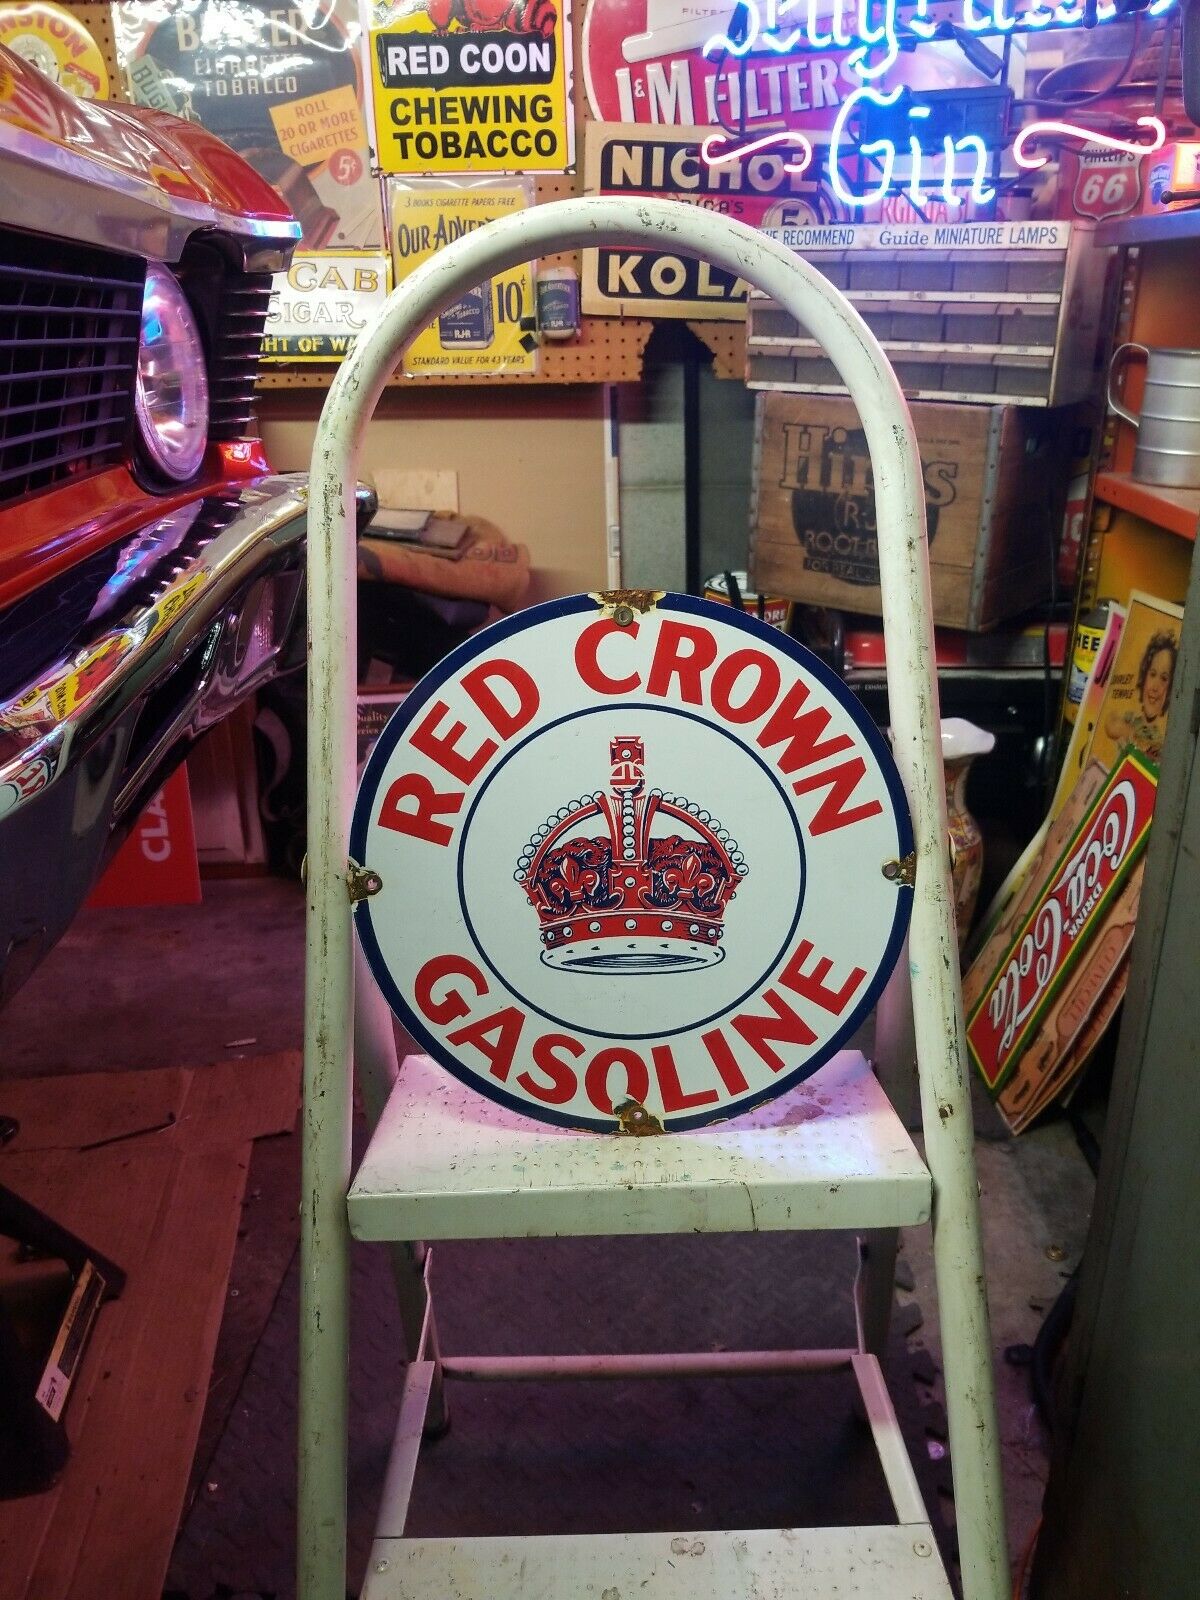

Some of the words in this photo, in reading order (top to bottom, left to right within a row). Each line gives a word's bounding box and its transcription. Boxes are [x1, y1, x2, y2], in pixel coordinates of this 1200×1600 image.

[176, 9, 312, 52] BER
[387, 45, 450, 76] RED
[459, 43, 551, 74] COON
[203, 77, 298, 97] TOBACCO
[295, 100, 329, 118] ROLL
[390, 94, 553, 126] CHEWING
[280, 128, 296, 142] 20
[296, 123, 317, 138] OR
[319, 110, 358, 133] MORE
[289, 127, 358, 157] CIGARETTES
[393, 129, 557, 160] TOBACCO
[830, 87, 998, 206] Gin
[610, 144, 819, 193] NICHOL
[436, 198, 469, 207] CIGARETTE
[471, 197, 496, 206] PAPERS
[497, 197, 516, 207] FREE
[1081, 173, 1128, 205] 66
[783, 229, 854, 247] RECOMMEND
[879, 229, 929, 246] Guide
[934, 227, 1004, 245] MINIATURE
[1009, 226, 1058, 244] LAMPS
[286, 261, 379, 292] CAB
[266, 296, 367, 329] CIGAR
[298, 335, 325, 353] OF
[476, 355, 491, 364] FOR
[377, 658, 541, 849] RED
[574, 617, 884, 838] CROWN
[1063, 883, 1103, 941] DRINK
[414, 938, 868, 1116] GASOLINE
